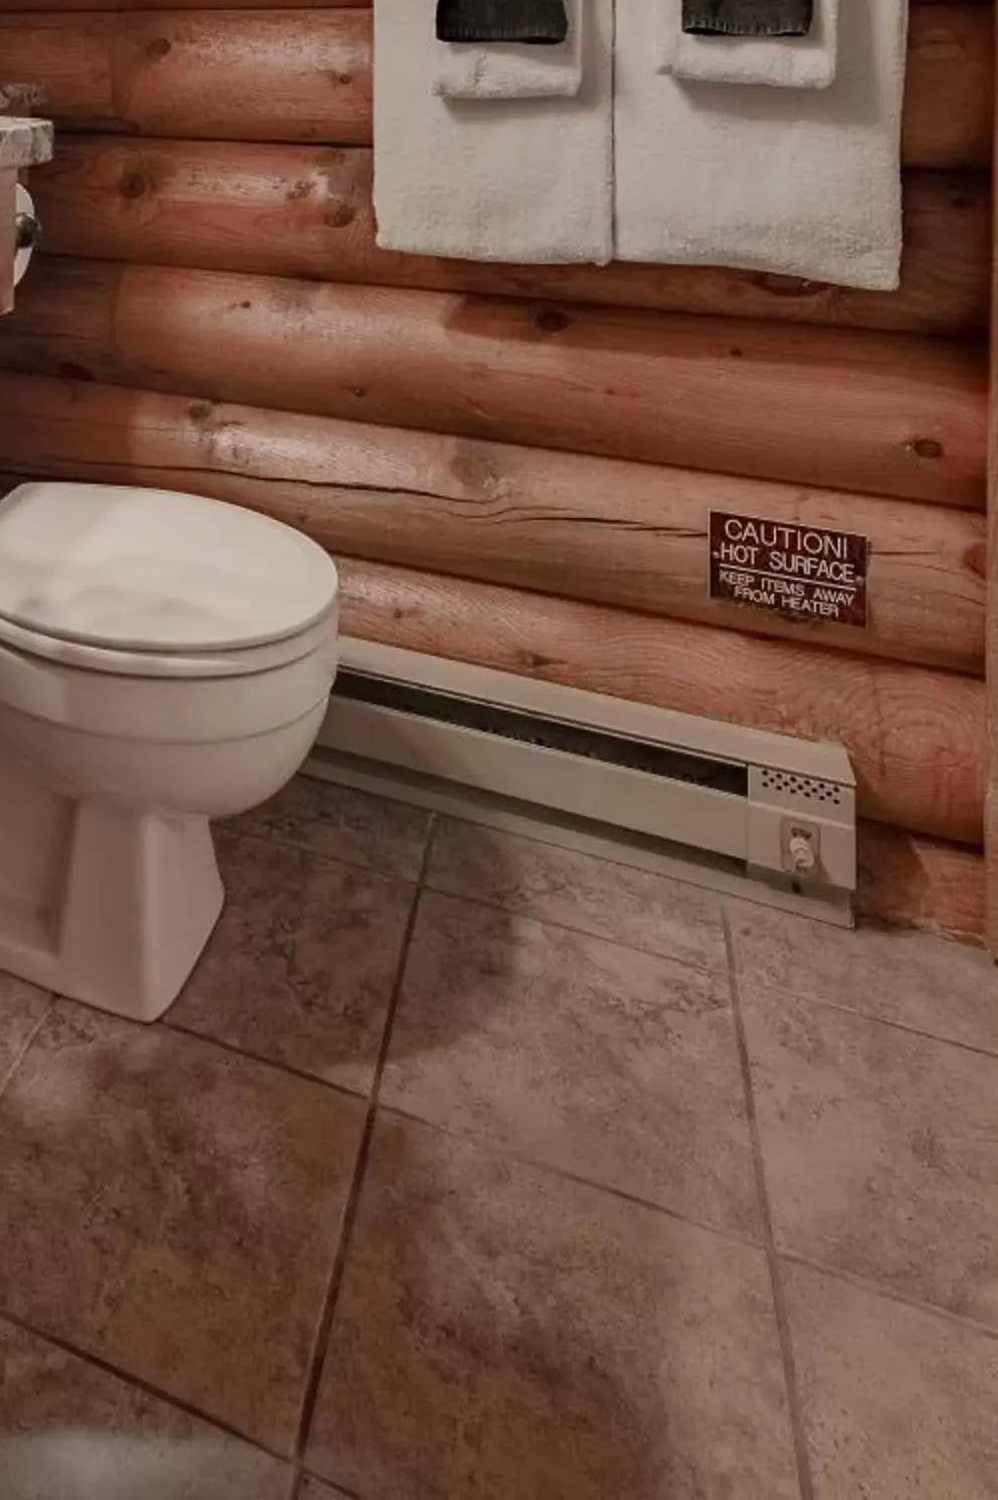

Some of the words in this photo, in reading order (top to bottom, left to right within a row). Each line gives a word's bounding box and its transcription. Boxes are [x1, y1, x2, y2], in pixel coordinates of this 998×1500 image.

[720, 542, 758, 565] HOT
[769, 551, 855, 583] SURFACE
[719, 570, 755, 586] KEEP
[761, 577, 805, 597] ITEMS
[813, 587, 855, 606] AWAY
[734, 586, 775, 606] FROM
[782, 597, 840, 618] HEATER
